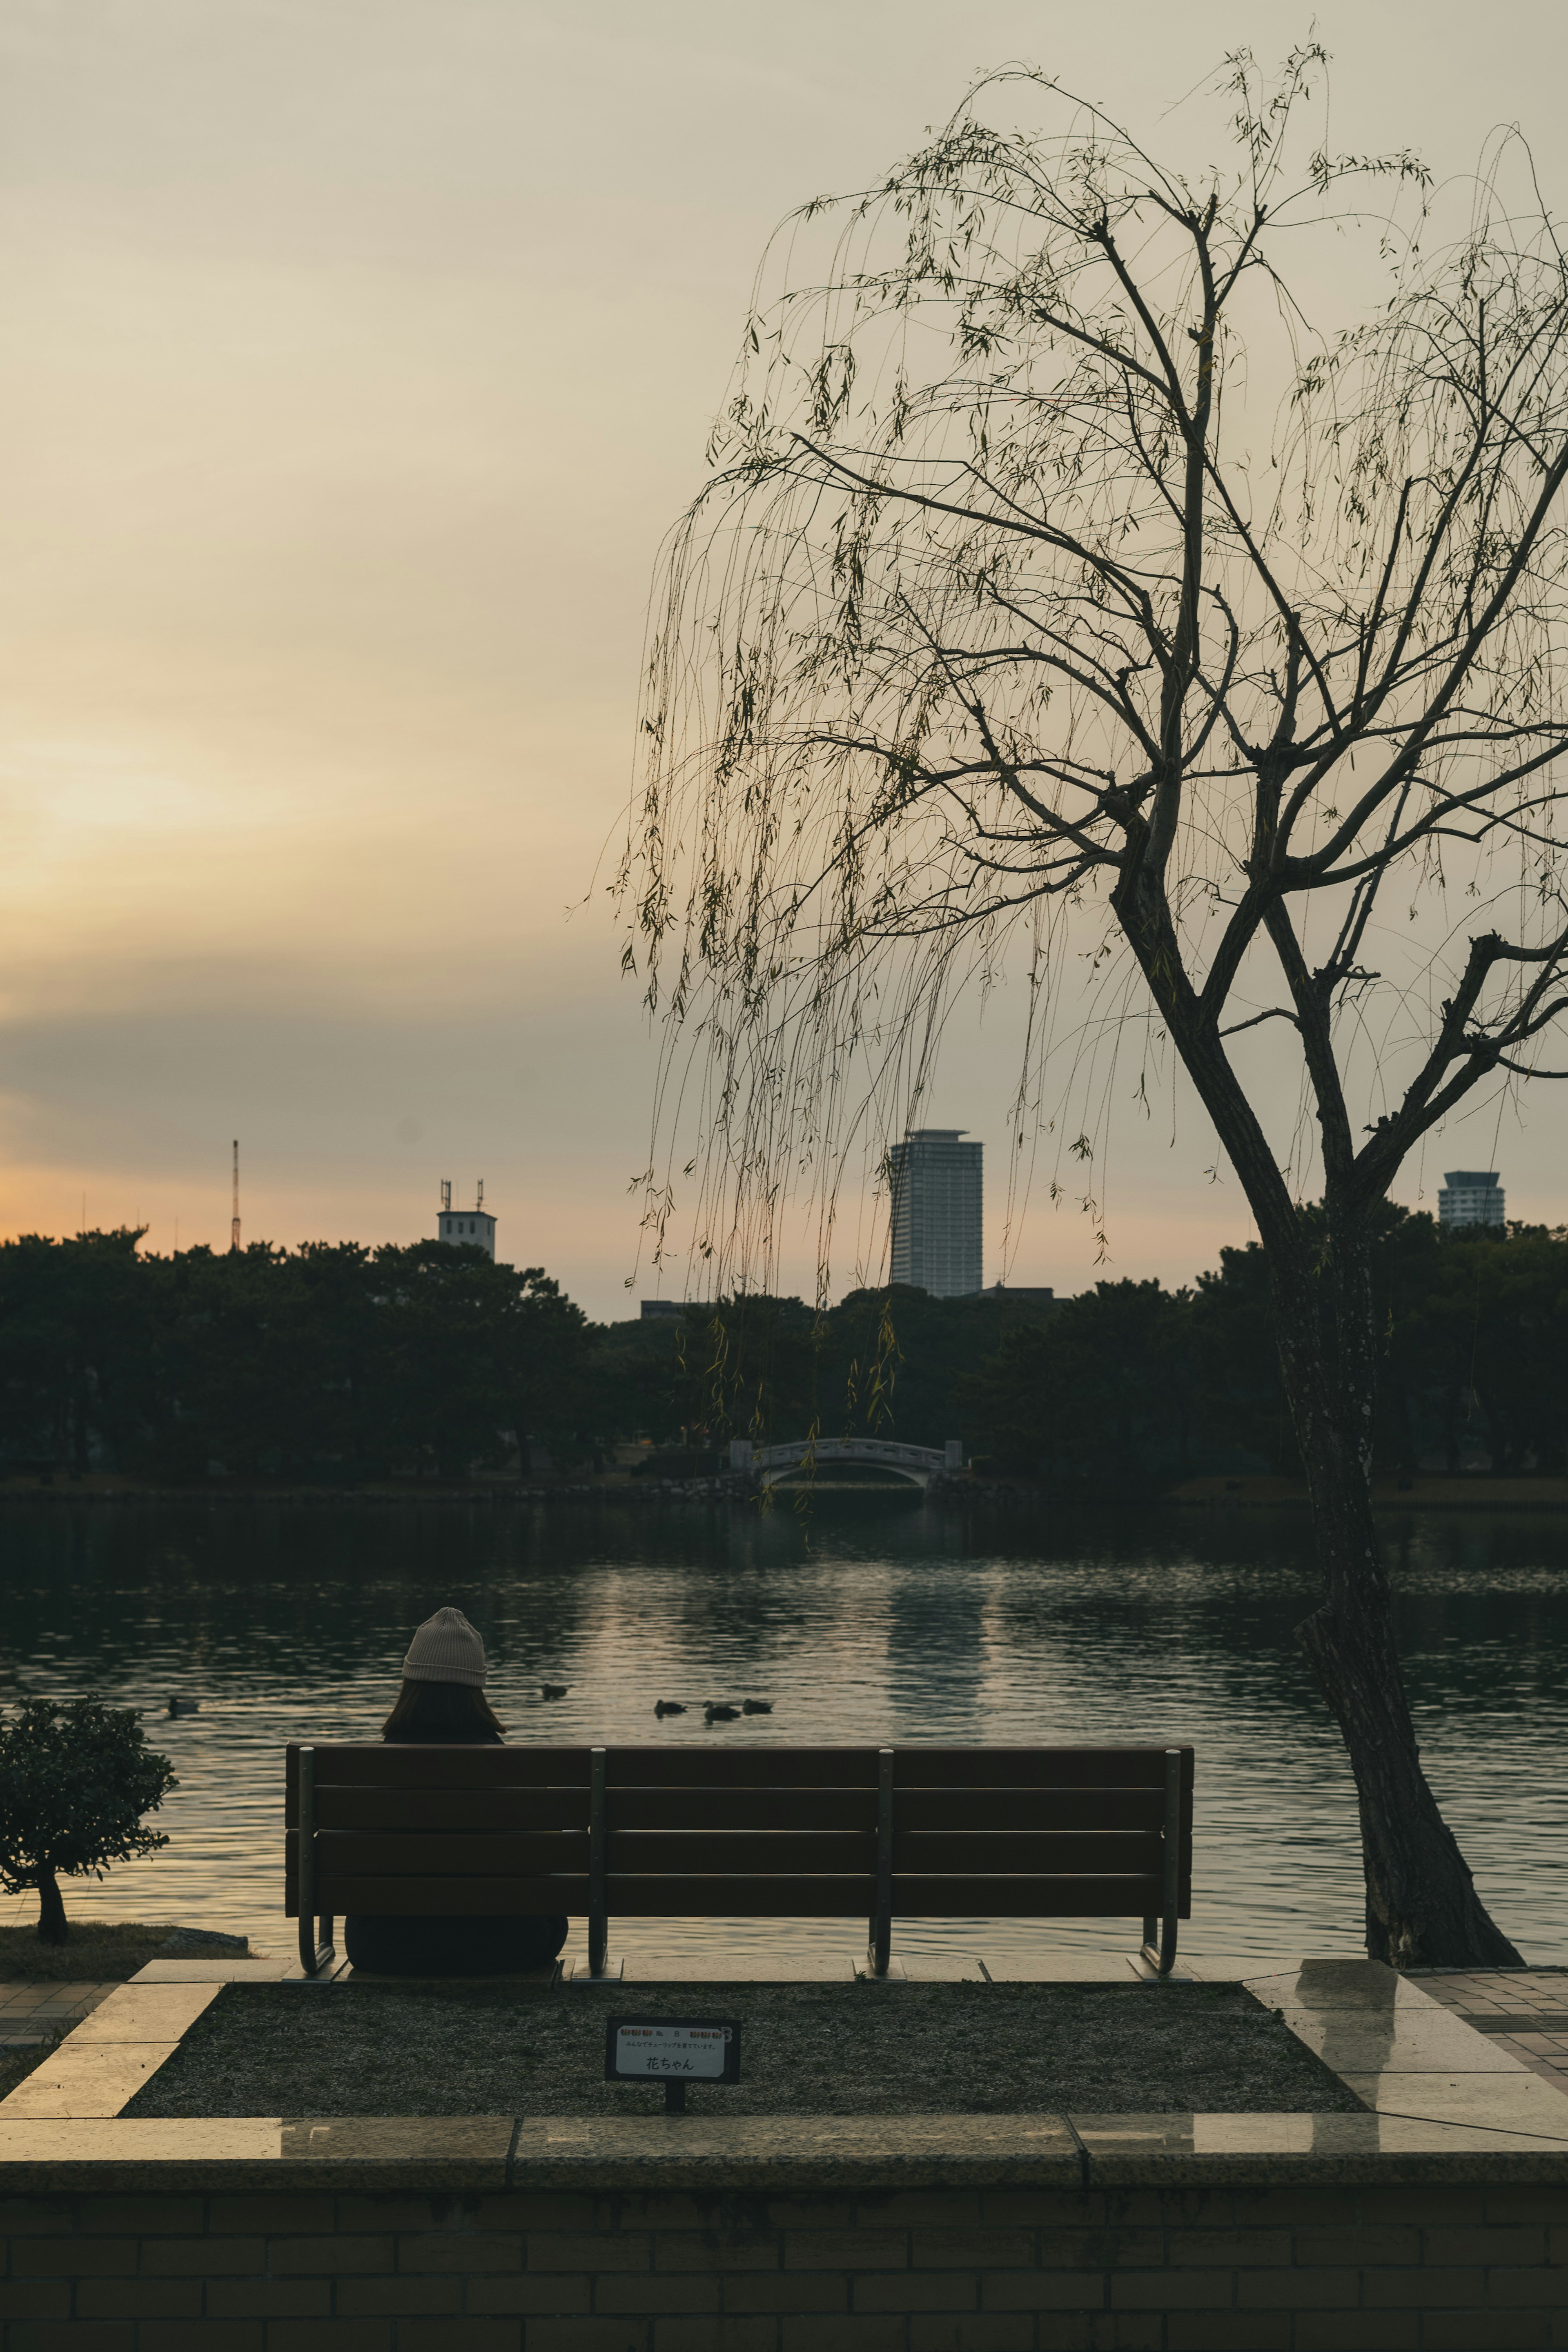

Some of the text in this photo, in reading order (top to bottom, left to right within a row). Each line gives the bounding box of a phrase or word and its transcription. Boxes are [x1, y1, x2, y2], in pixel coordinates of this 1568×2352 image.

[626, 2041, 716, 2050] みんなでチューリップを育てています。
[646, 2057, 694, 2070] 花ちゃん
